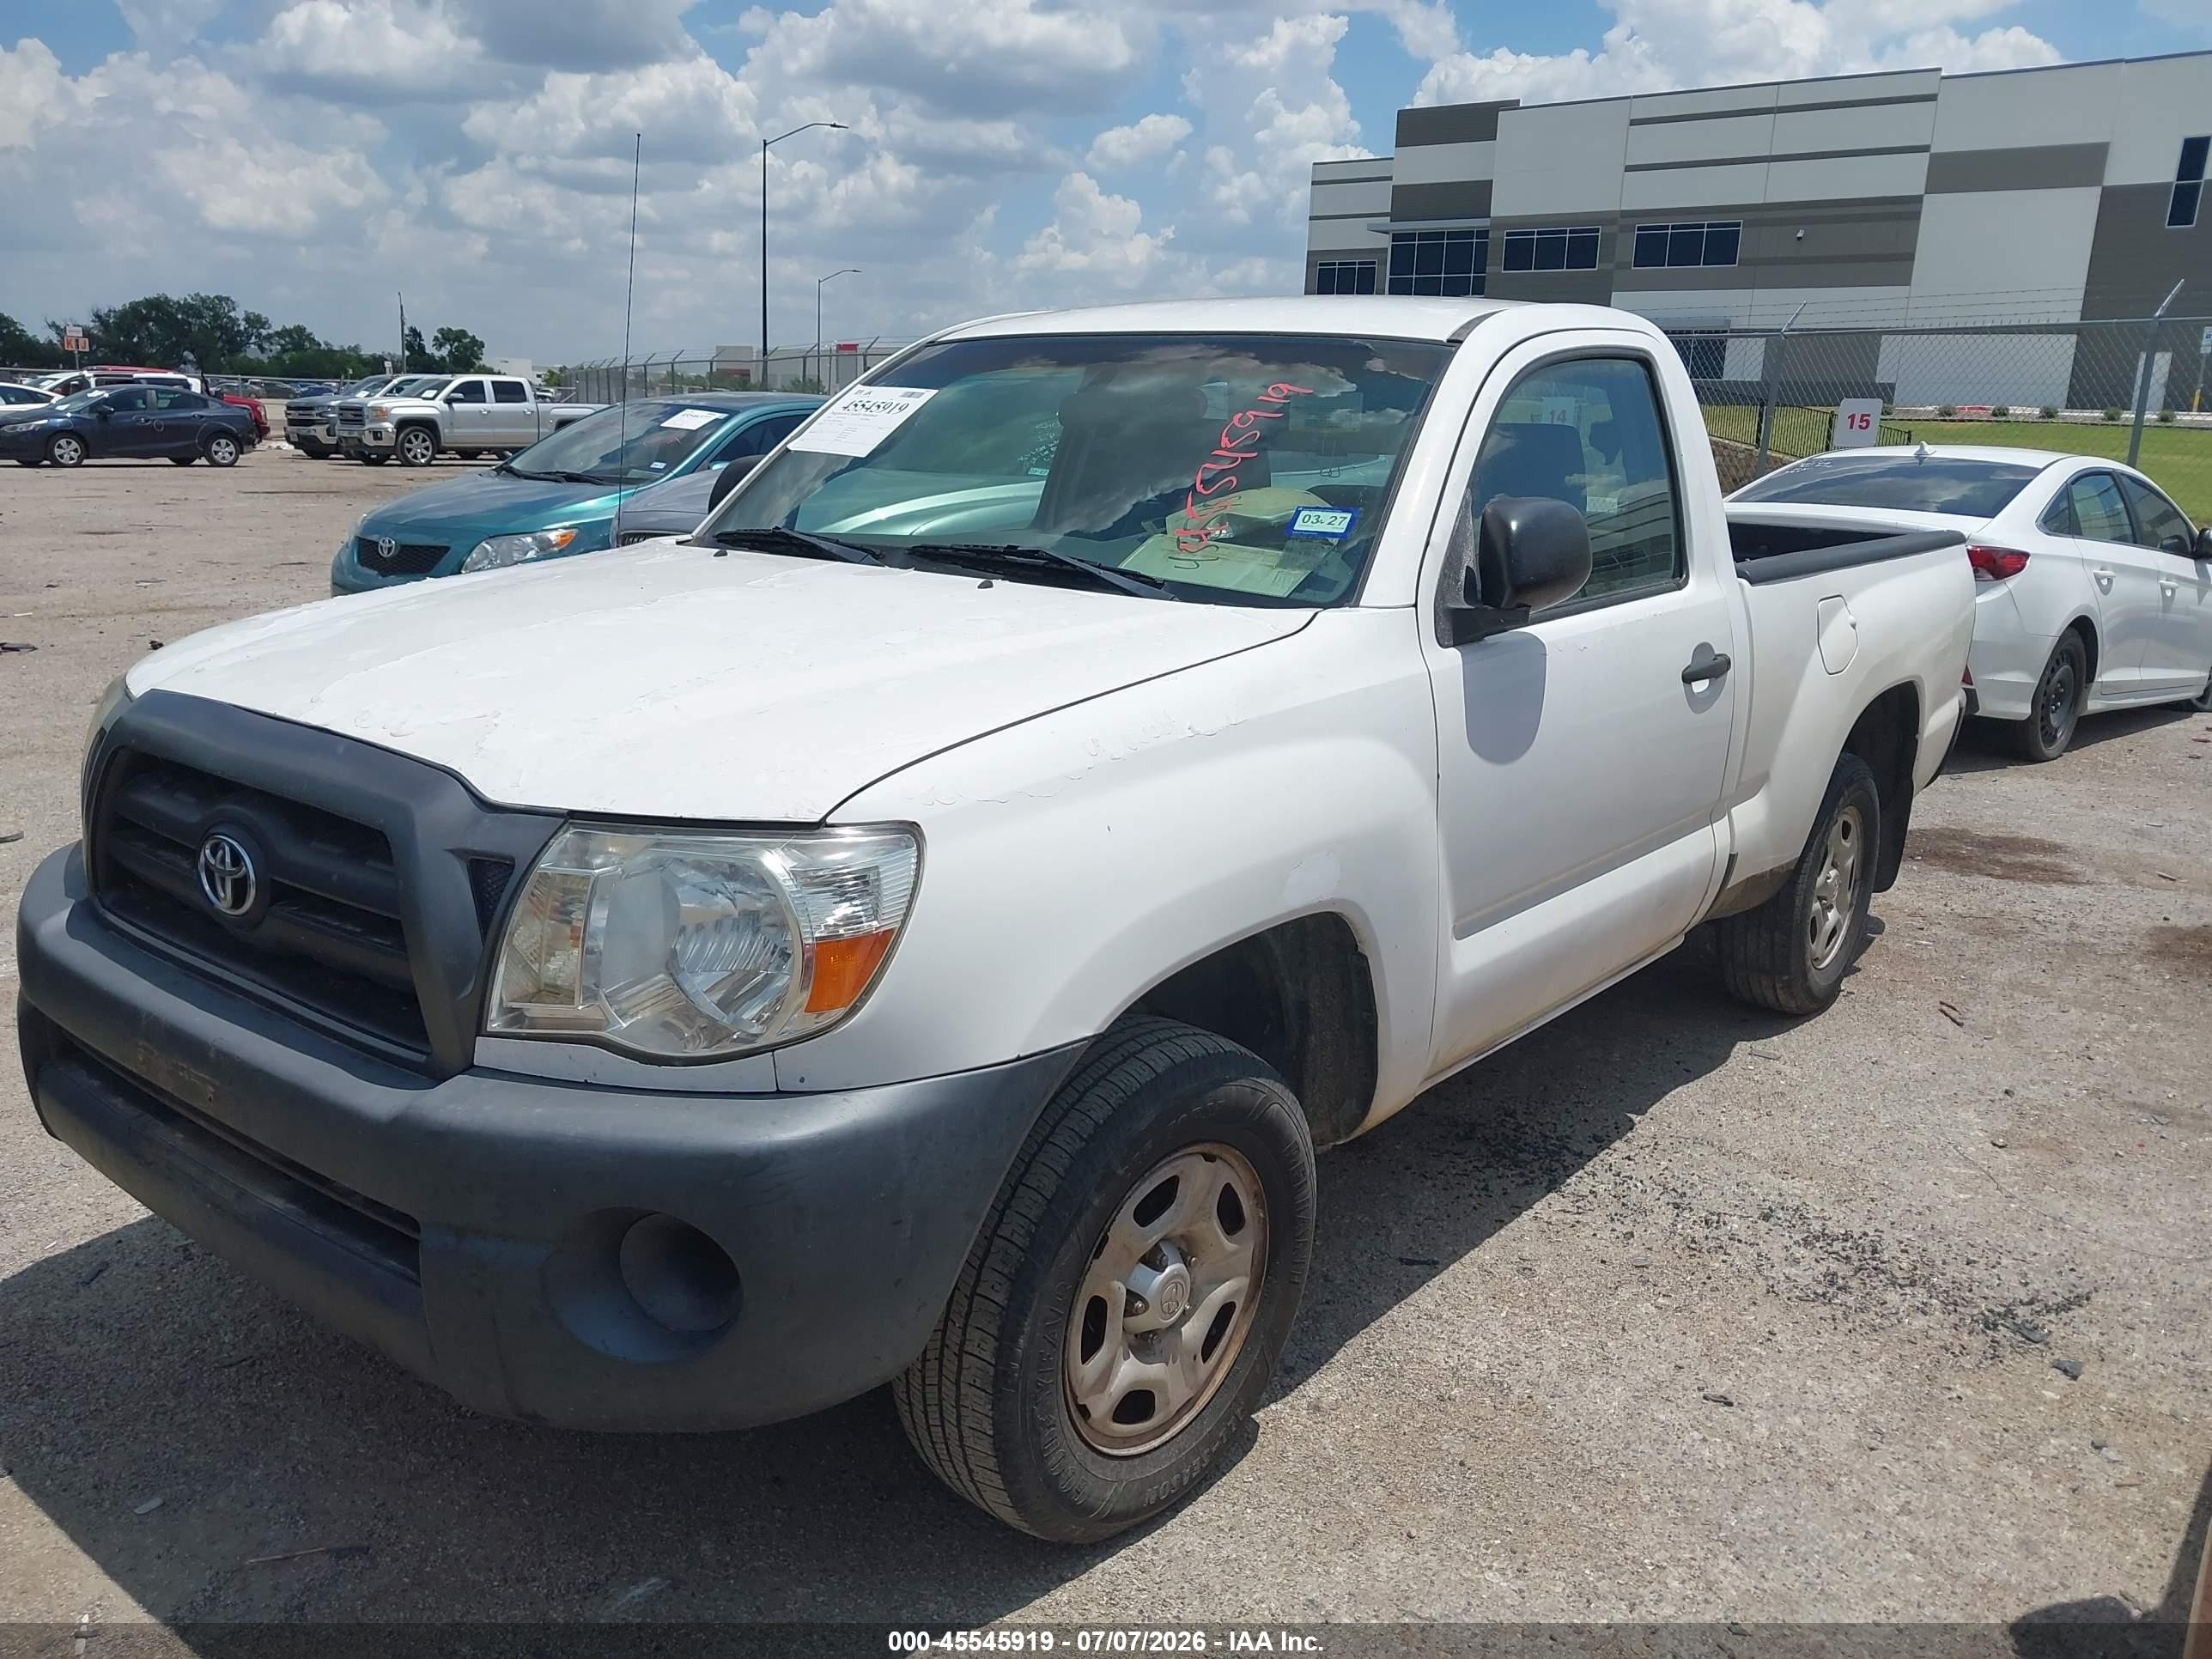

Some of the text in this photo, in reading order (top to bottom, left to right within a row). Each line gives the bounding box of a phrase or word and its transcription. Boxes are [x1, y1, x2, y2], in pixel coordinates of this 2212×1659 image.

[842, 398, 910, 415] 45545919
[1847, 412, 1872, 430] 15
[1302, 514, 1348, 526] 03 27
